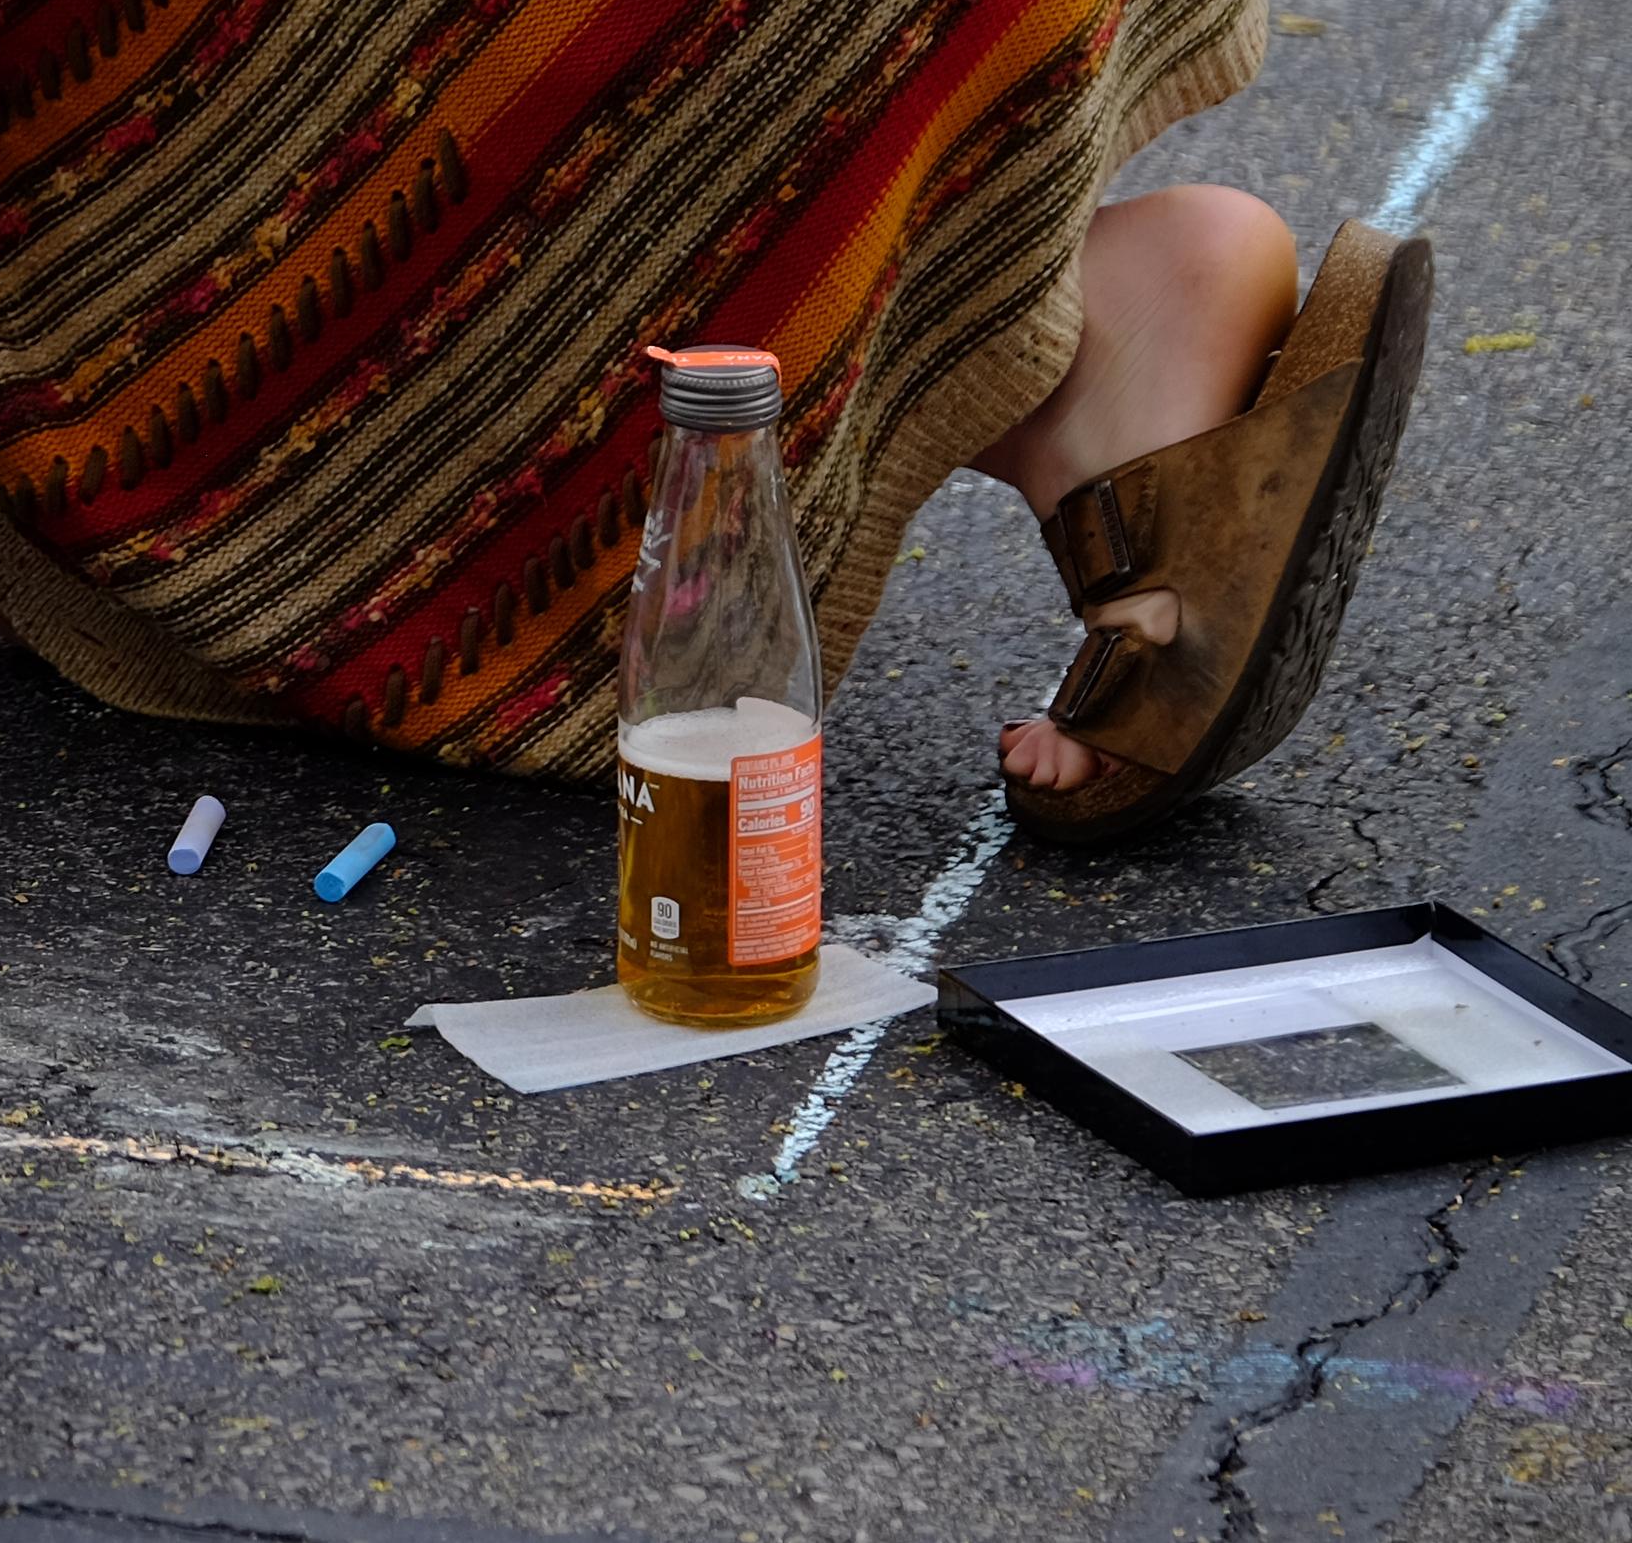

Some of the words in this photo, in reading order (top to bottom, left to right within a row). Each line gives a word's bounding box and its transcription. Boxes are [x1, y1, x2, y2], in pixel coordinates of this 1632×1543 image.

[738, 772, 793, 791] Nutrition
[795, 762, 816, 781] Facts
[738, 815, 786, 832] Calories
[800, 796, 815, 819] 90
[657, 902, 672, 919] 90
